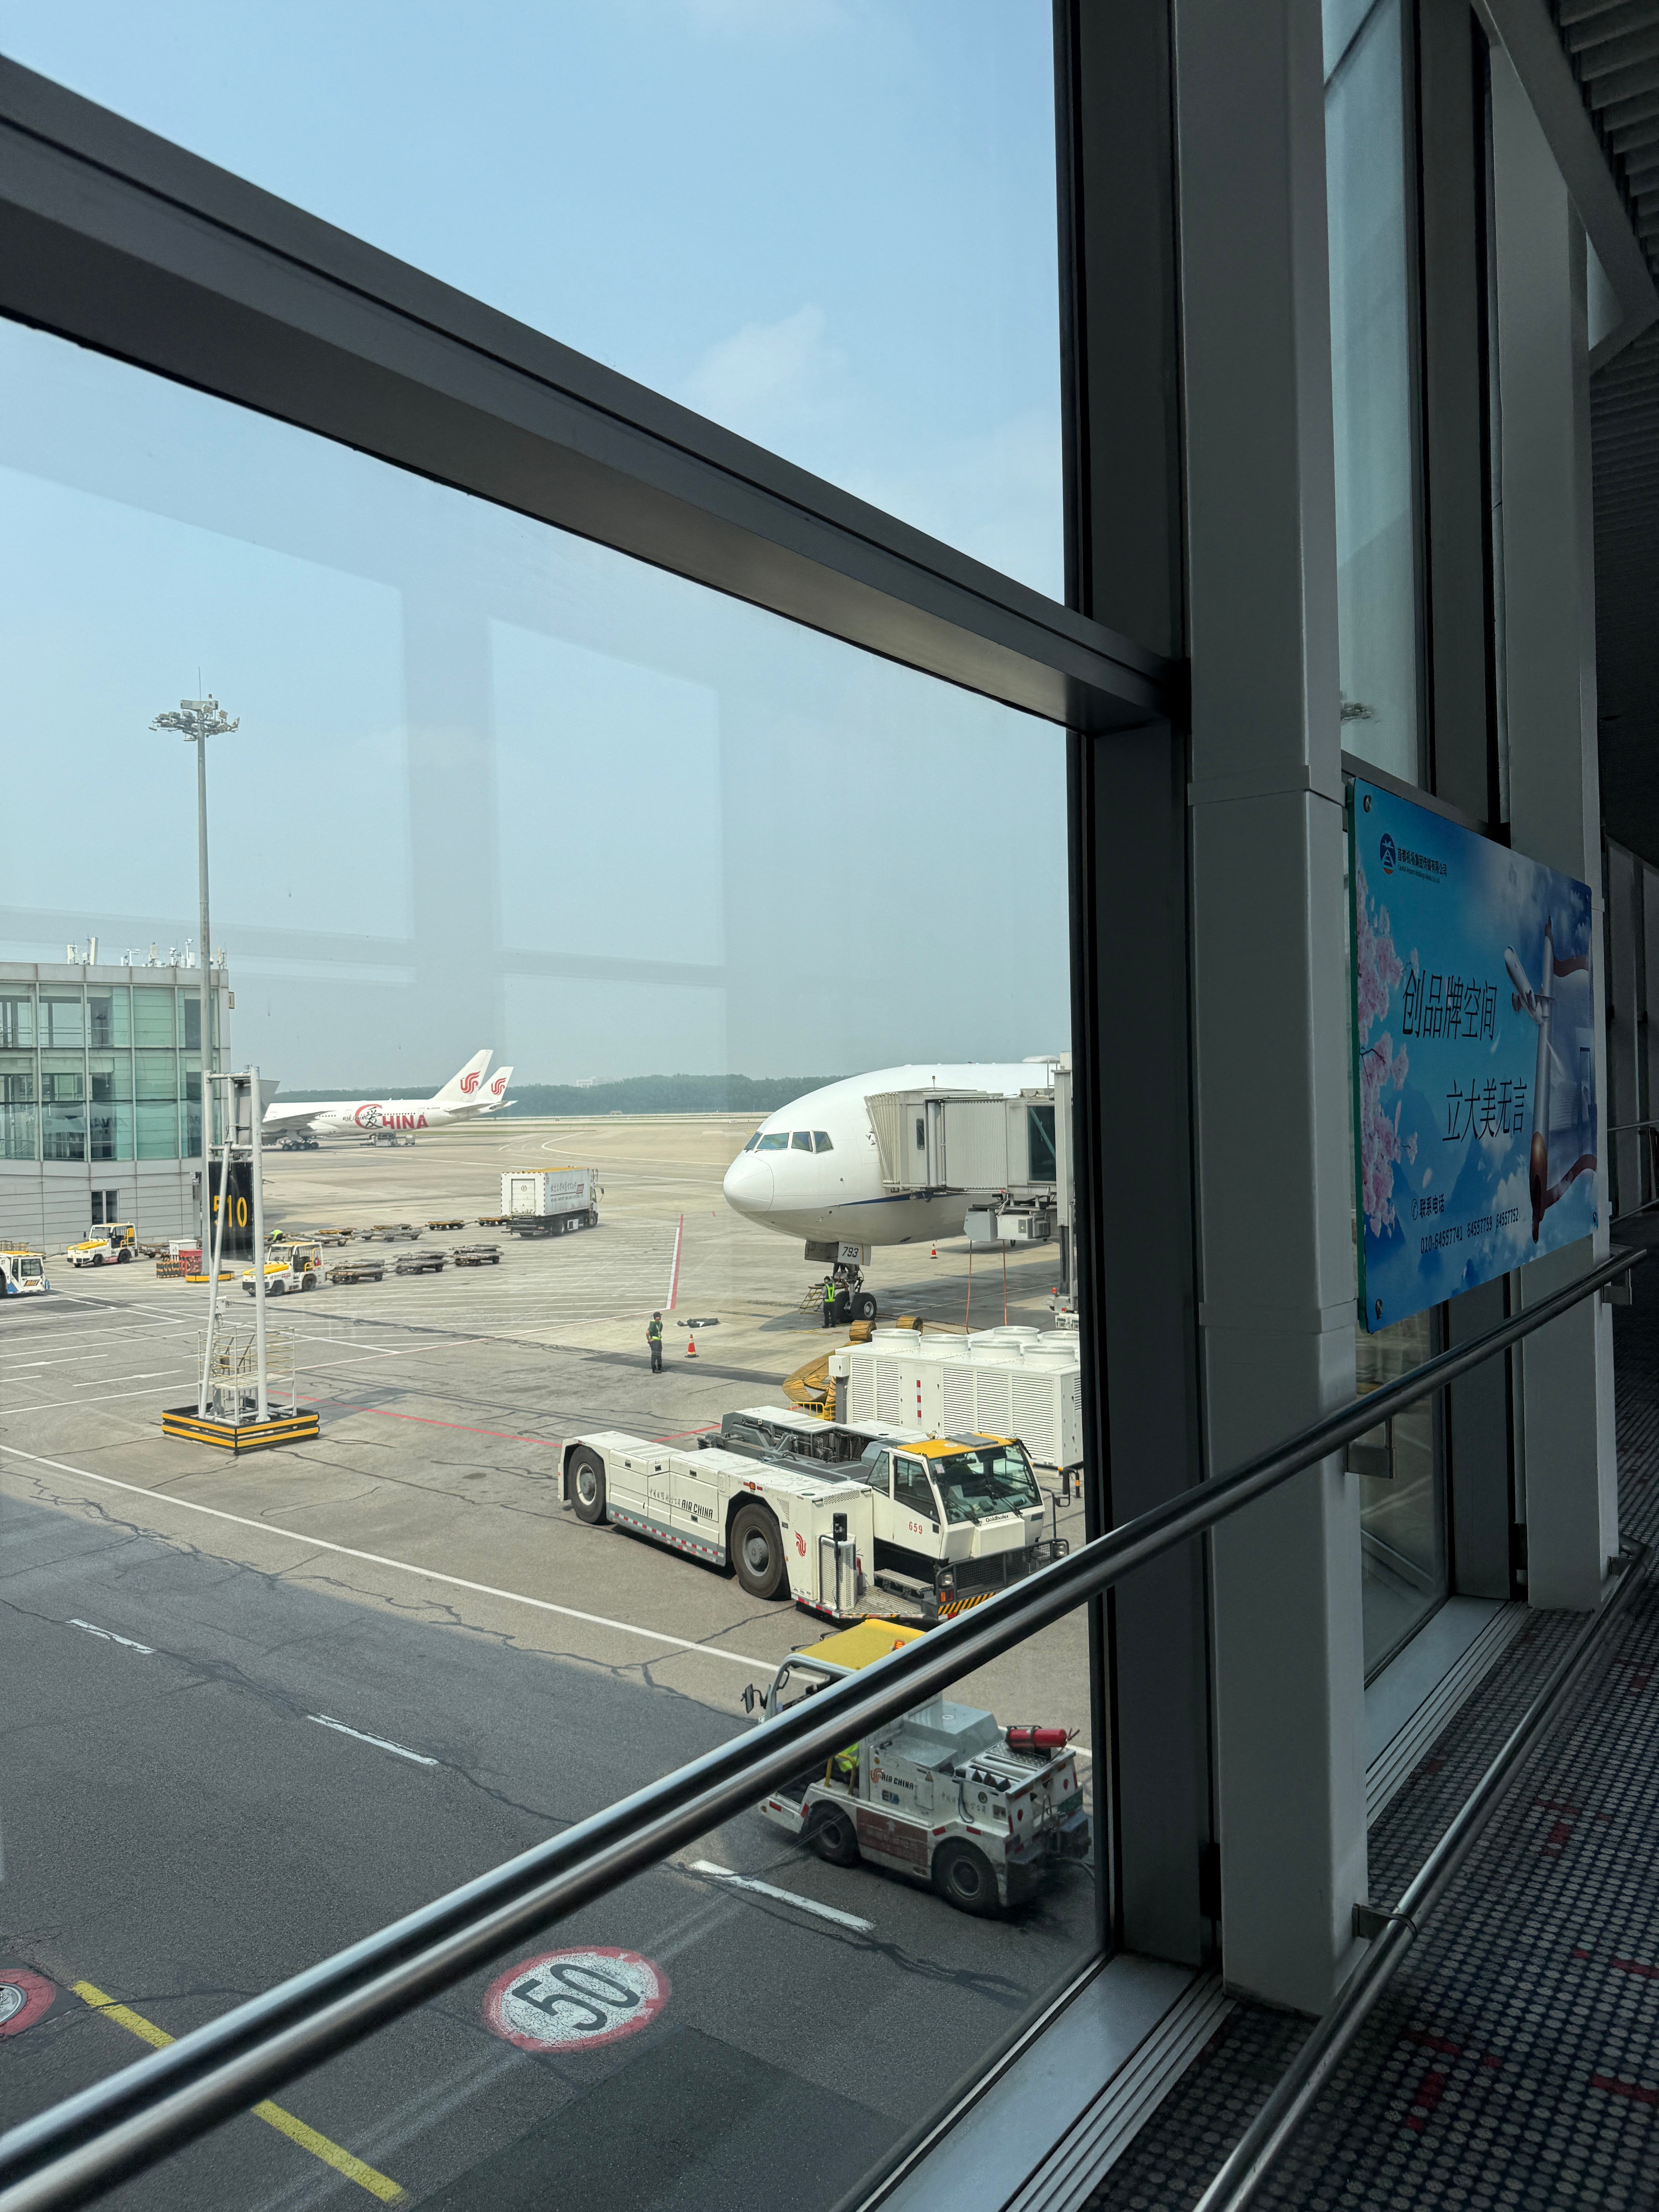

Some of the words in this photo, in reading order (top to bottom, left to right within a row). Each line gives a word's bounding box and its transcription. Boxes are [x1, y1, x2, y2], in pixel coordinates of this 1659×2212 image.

[1402, 970, 1497, 1041] 创品牌空间
[1442, 1077, 1527, 1142] 立大美无言
[1419, 1193, 1444, 1218] 联系电话
[1420, 1226, 1463, 1254] 010-64557741
[1496, 1207, 1518, 1228] 64557752
[842, 1247, 859, 1257] 793
[682, 1499, 692, 1511] AIR
[693, 1503, 713, 1519] CHINA
[986, 1514, 1009, 1523] Goldhofer
[909, 1521, 922, 1534] 659
[881, 1773, 892, 1783] AIR
[894, 1777, 914, 1790] CHINA
[512, 1963, 641, 2031] 50
